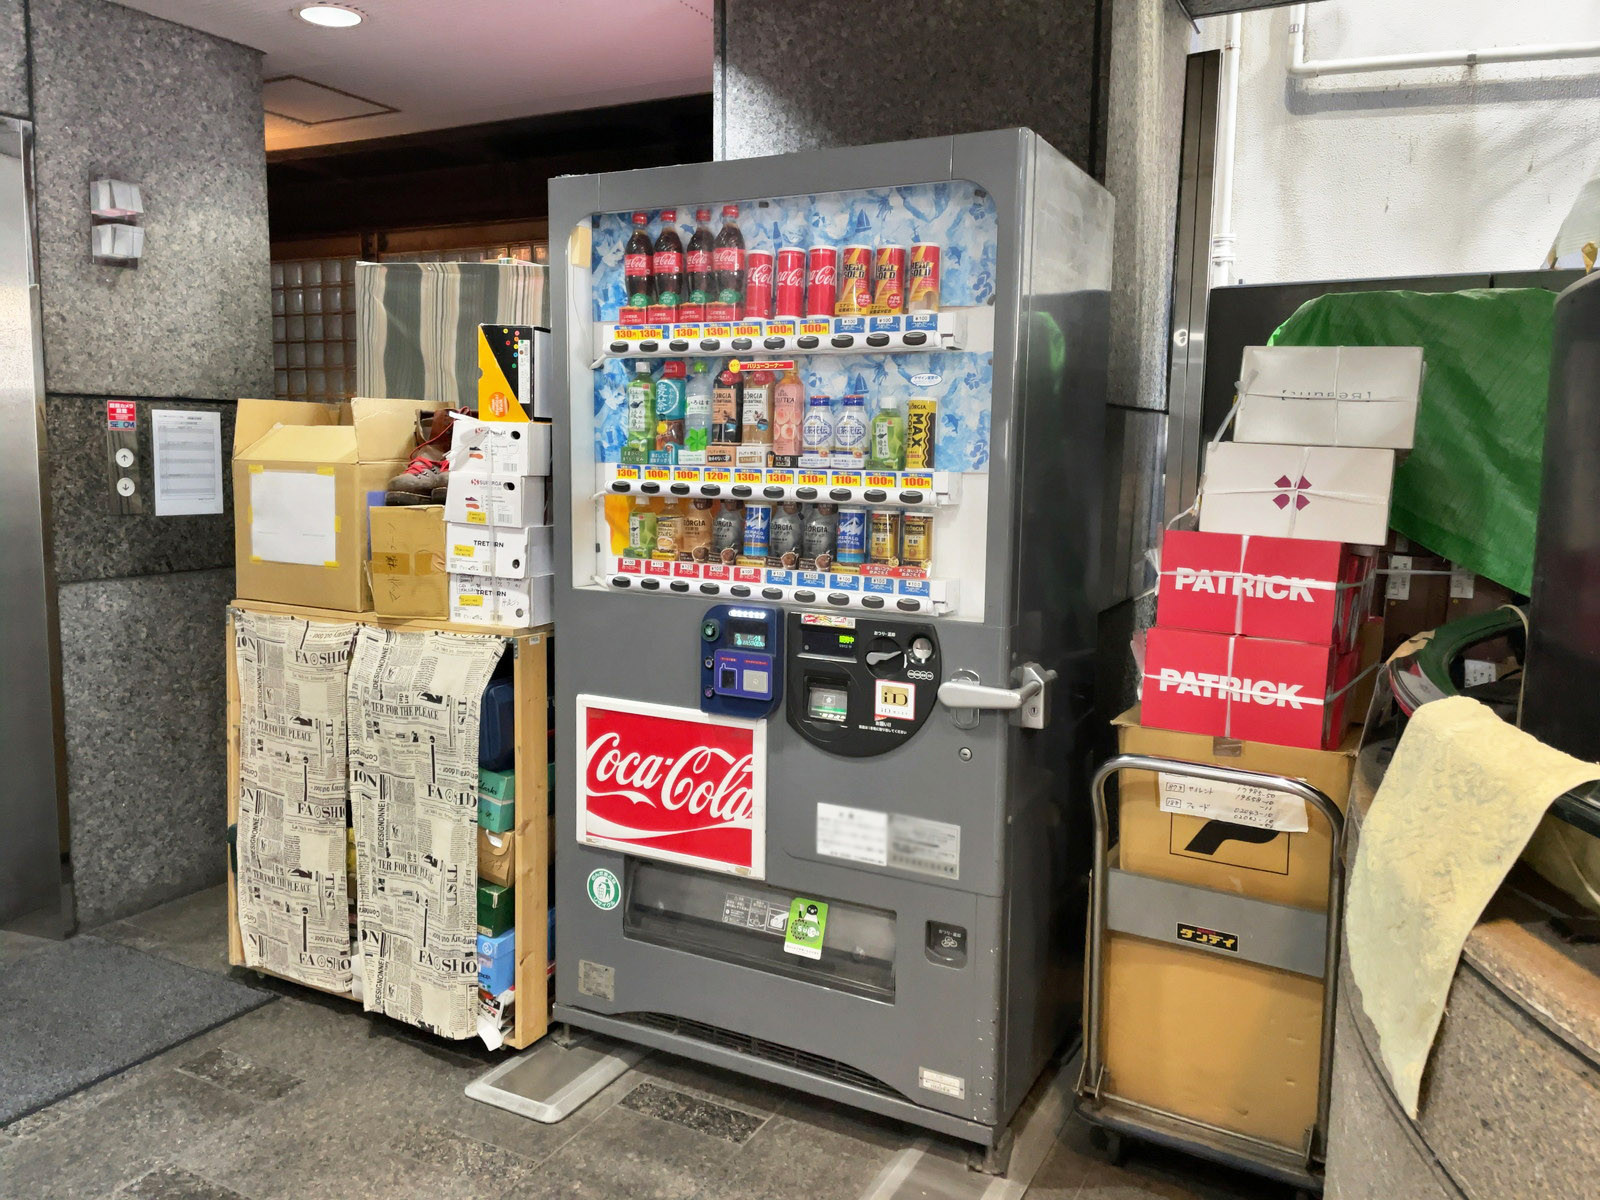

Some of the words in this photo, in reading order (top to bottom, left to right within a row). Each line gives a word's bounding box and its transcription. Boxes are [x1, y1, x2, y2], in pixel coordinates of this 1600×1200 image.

[640, 329, 660, 337] 130円
[675, 328, 698, 337] 130円
[705, 327, 729, 336] 130円
[735, 326, 759, 335] 100円
[768, 324, 793, 334] 100円
[803, 324, 827, 333] 100円
[616, 330, 637, 338] 130円
[912, 413, 924, 448] MAX
[617, 469, 637, 477] 130円
[647, 470, 669, 478] 100円
[676, 471, 698, 479] 100円
[706, 472, 729, 480] 120円
[737, 473, 760, 481] 130円
[769, 473, 792, 482] 130円
[801, 474, 824, 484] 110円
[835, 474, 858, 485] 110円
[867, 476, 893, 485] 100円
[903, 477, 930, 487] 100円
[473, 539, 504, 548] TRETRN
[1175, 567, 1315, 603] PATRICK
[476, 589, 507, 598] TRETRN
[1159, 668, 1304, 710] PATRICK
[884, 692, 908, 706] iD
[386, 704, 398, 716] FOR
[400, 706, 413, 717] THE
[394, 861, 407, 874] FOR
[797, 925, 820, 938] Suica
